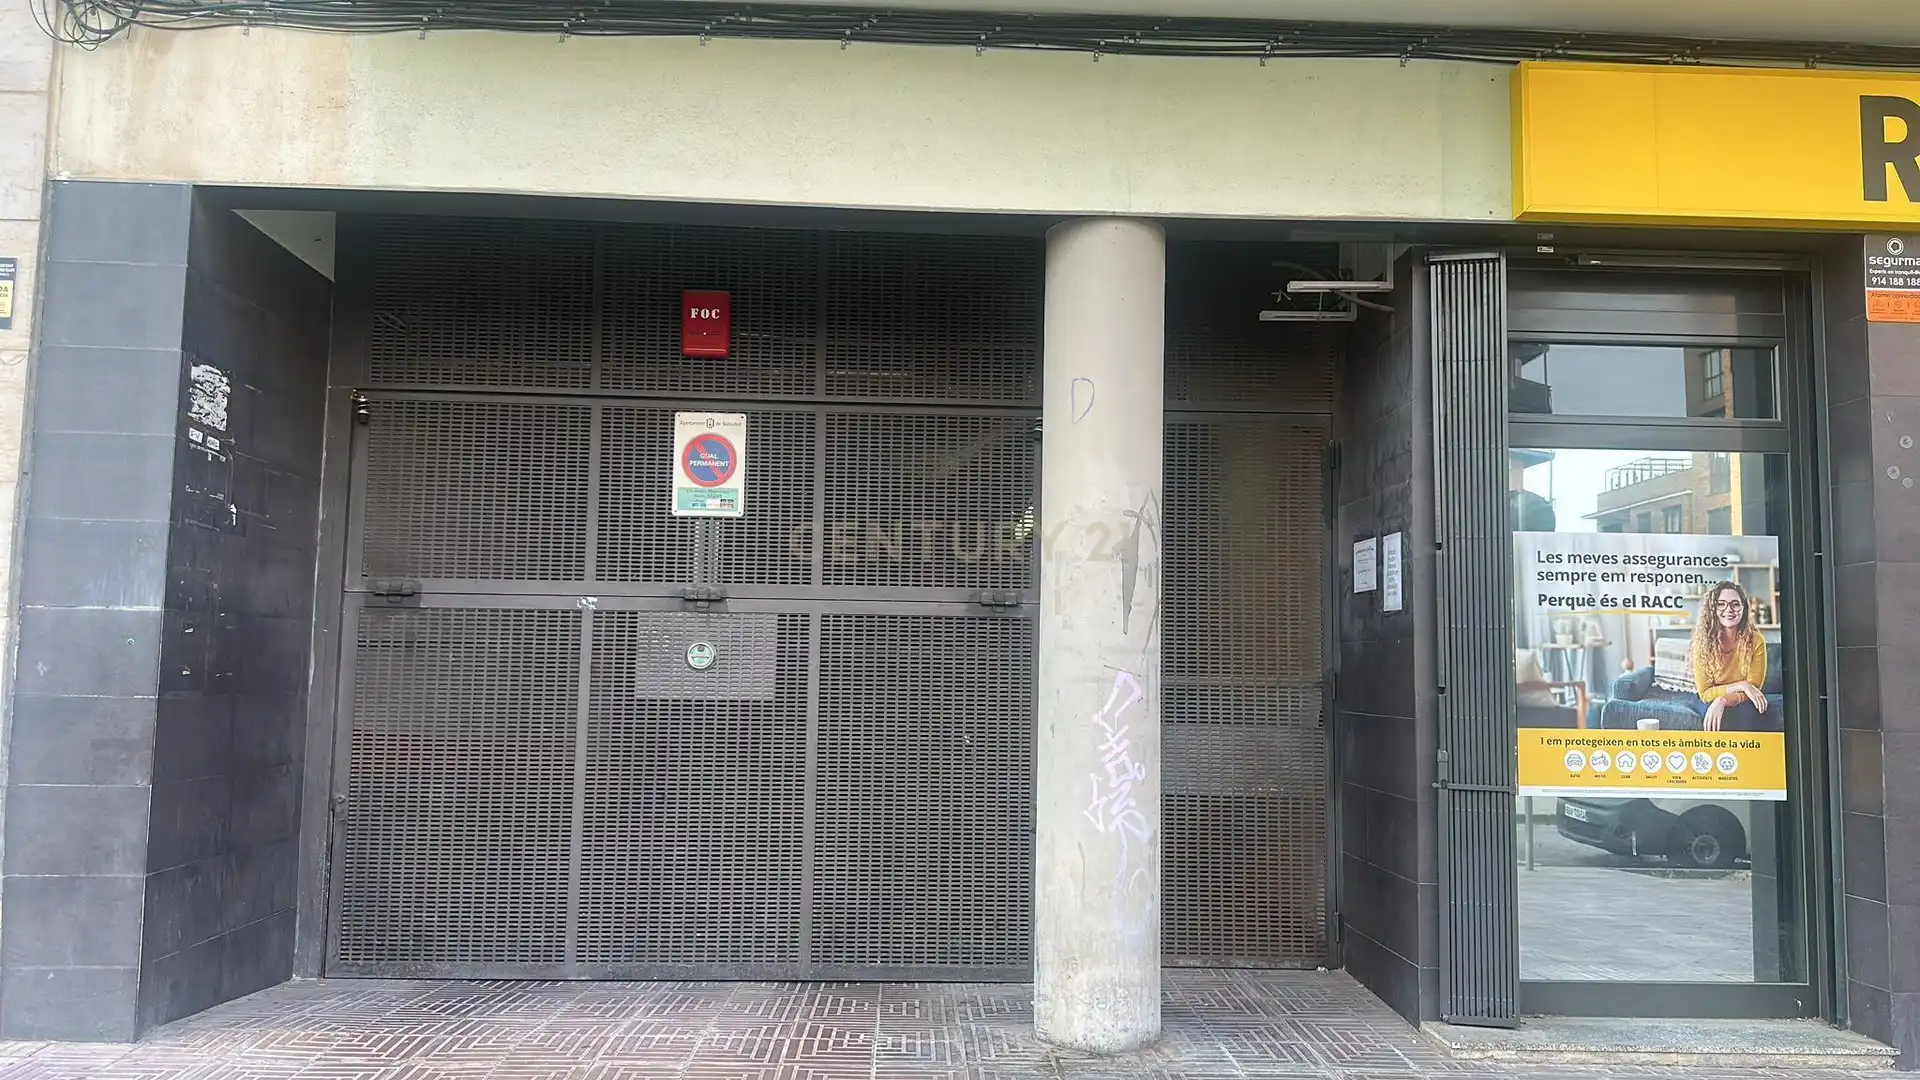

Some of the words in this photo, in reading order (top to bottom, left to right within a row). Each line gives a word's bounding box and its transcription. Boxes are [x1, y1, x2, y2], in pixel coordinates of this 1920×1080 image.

[1860, 95, 1920, 201] R
[1871, 276, 1887, 286] 914
[1889, 277, 1904, 287] 188
[1906, 277, 1920, 287] 188
[690, 307, 720, 319] FOC
[1537, 550, 1563, 564] Les
[1567, 553, 1619, 565] meves
[1622, 553, 1729, 569] assegurances
[1536, 570, 1597, 586] sempre
[1600, 572, 1626, 583] em
[1630, 572, 1717, 587] responen...
[1537, 592, 1596, 611] Perquè
[1599, 593, 1618, 608] és
[1622, 594, 1637, 608] el
[1641, 595, 1684, 609] RACC
[1540, 737, 1544, 745] I
[1565, 738, 1624, 749] protegeixen
[1641, 739, 1660, 747] tots
[1662, 739, 1676, 747] els
[1679, 739, 1713, 748] àmbits
[1714, 739, 1727, 748] de
[1729, 740, 1738, 748] la
[1740, 740, 1761, 749] vida
